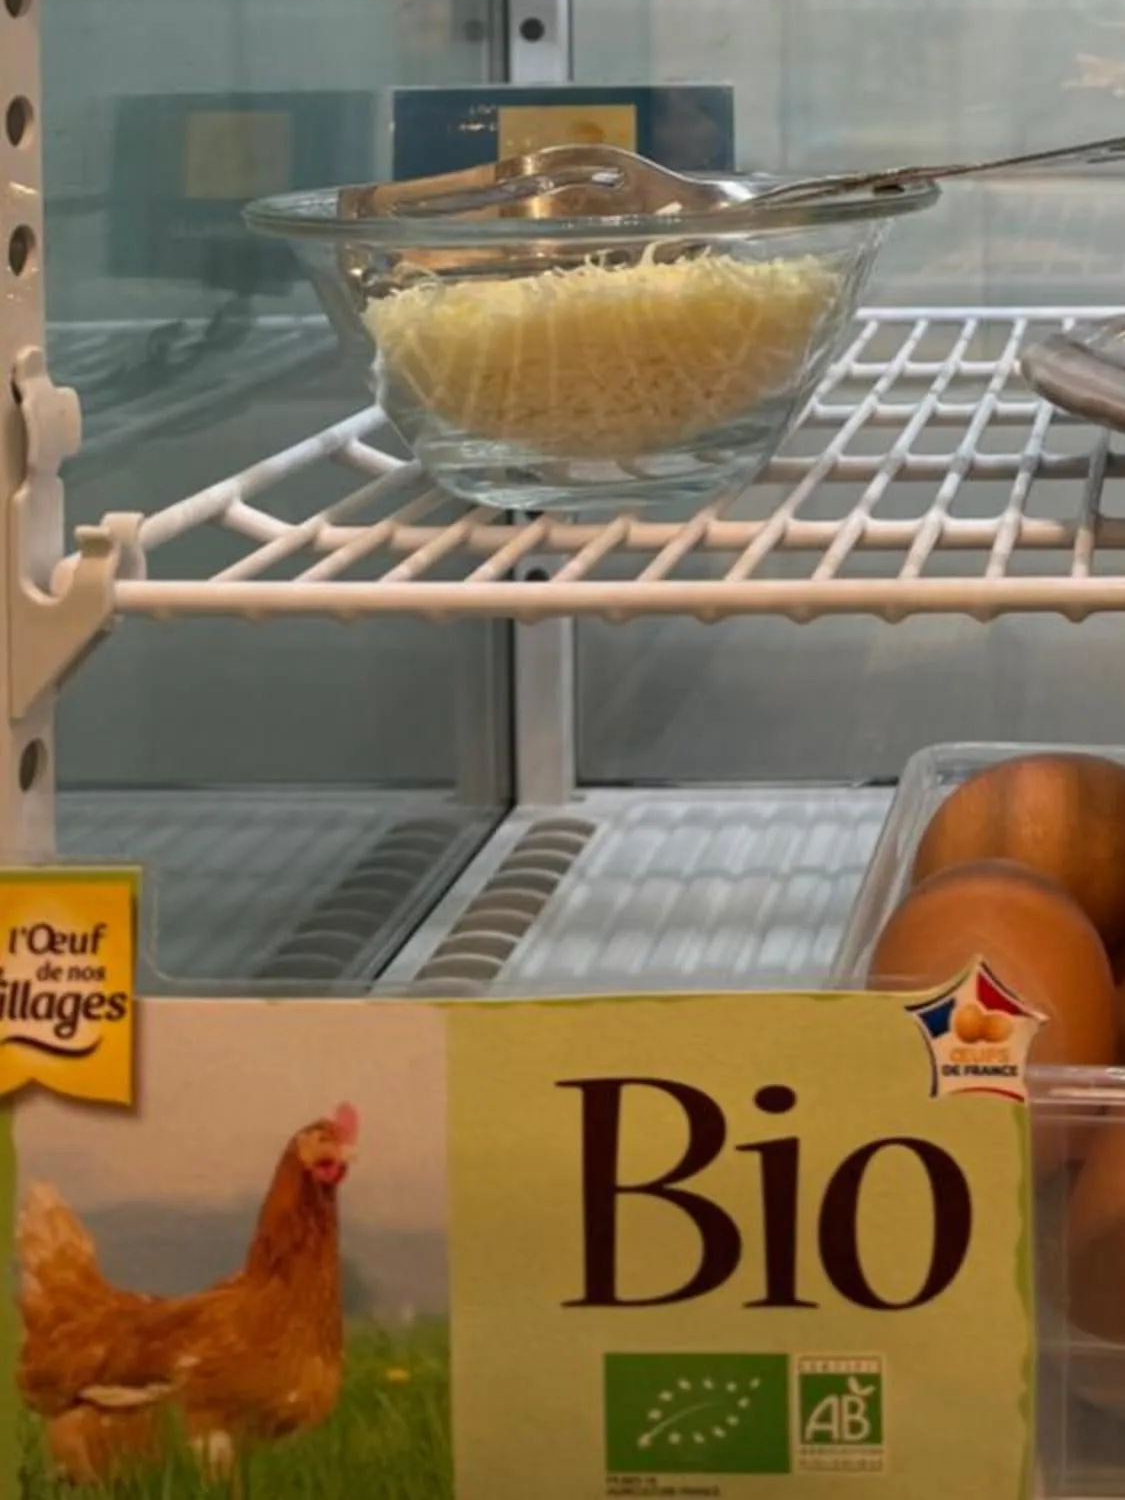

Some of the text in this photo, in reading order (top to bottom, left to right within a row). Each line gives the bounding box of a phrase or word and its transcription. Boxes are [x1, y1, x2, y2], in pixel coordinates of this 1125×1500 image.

[36, 960, 106, 982] de nos
[0, 980, 129, 1040] illages
[941, 1065, 1018, 1077] DE FRANCE
[555, 1078, 973, 1311] Bio
[804, 1395, 871, 1442] AB
